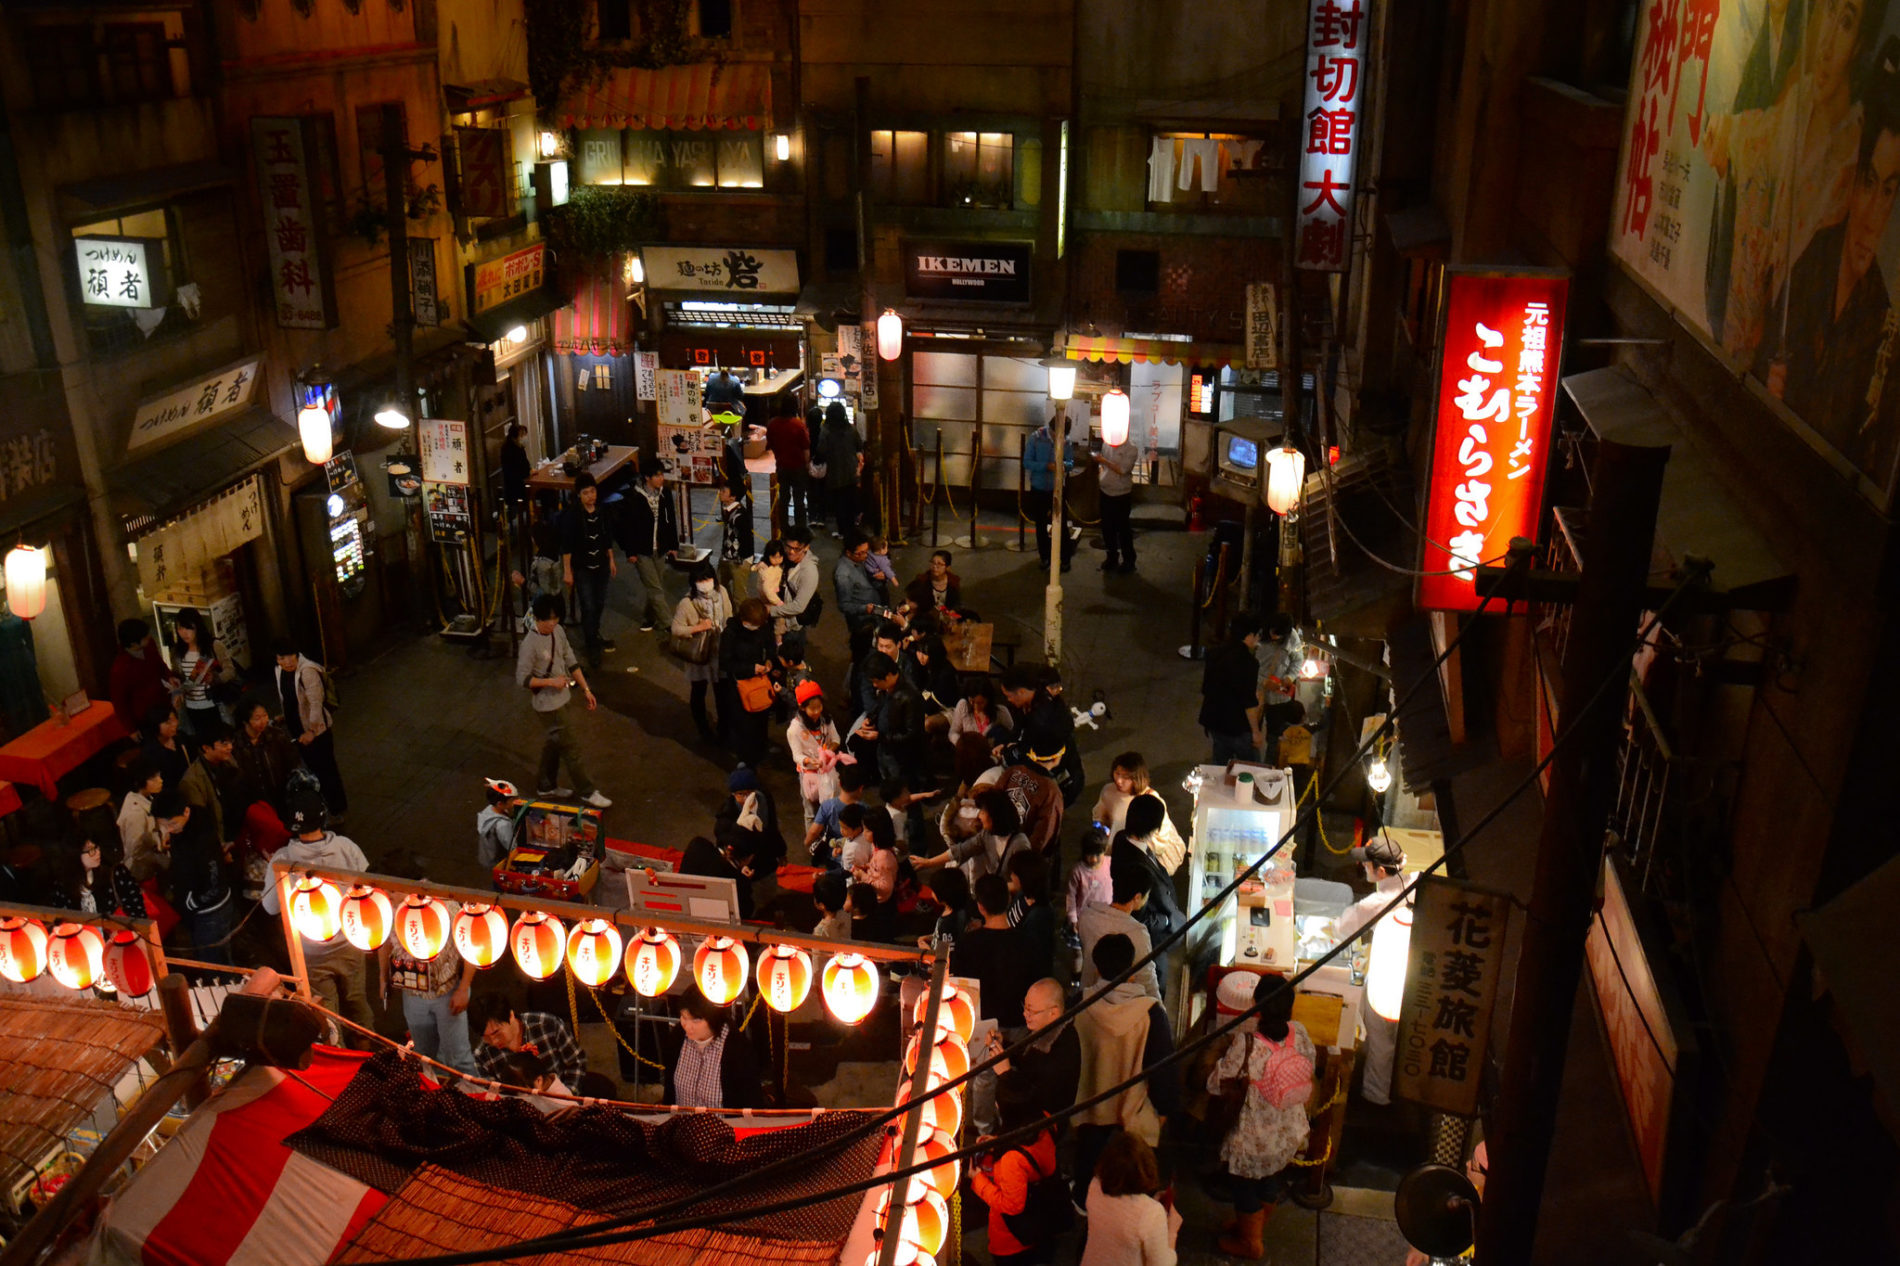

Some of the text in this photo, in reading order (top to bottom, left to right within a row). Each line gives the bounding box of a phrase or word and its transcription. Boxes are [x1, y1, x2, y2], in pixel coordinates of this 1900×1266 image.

[264, 130, 316, 297] 玉置歯科
[85, 247, 137, 265] つけめん
[87, 268, 142, 301] 頑者
[676, 260, 722, 277] 麺の坊
[916, 255, 1017, 276] IKEMEN
[138, 371, 249, 431] つけめん 頑者
[1507, 302, 1550, 480] 元祖熊本ラーメン
[1449, 322, 1511, 582] こむらさき
[1428, 901, 1494, 1082] 花菱旅館
